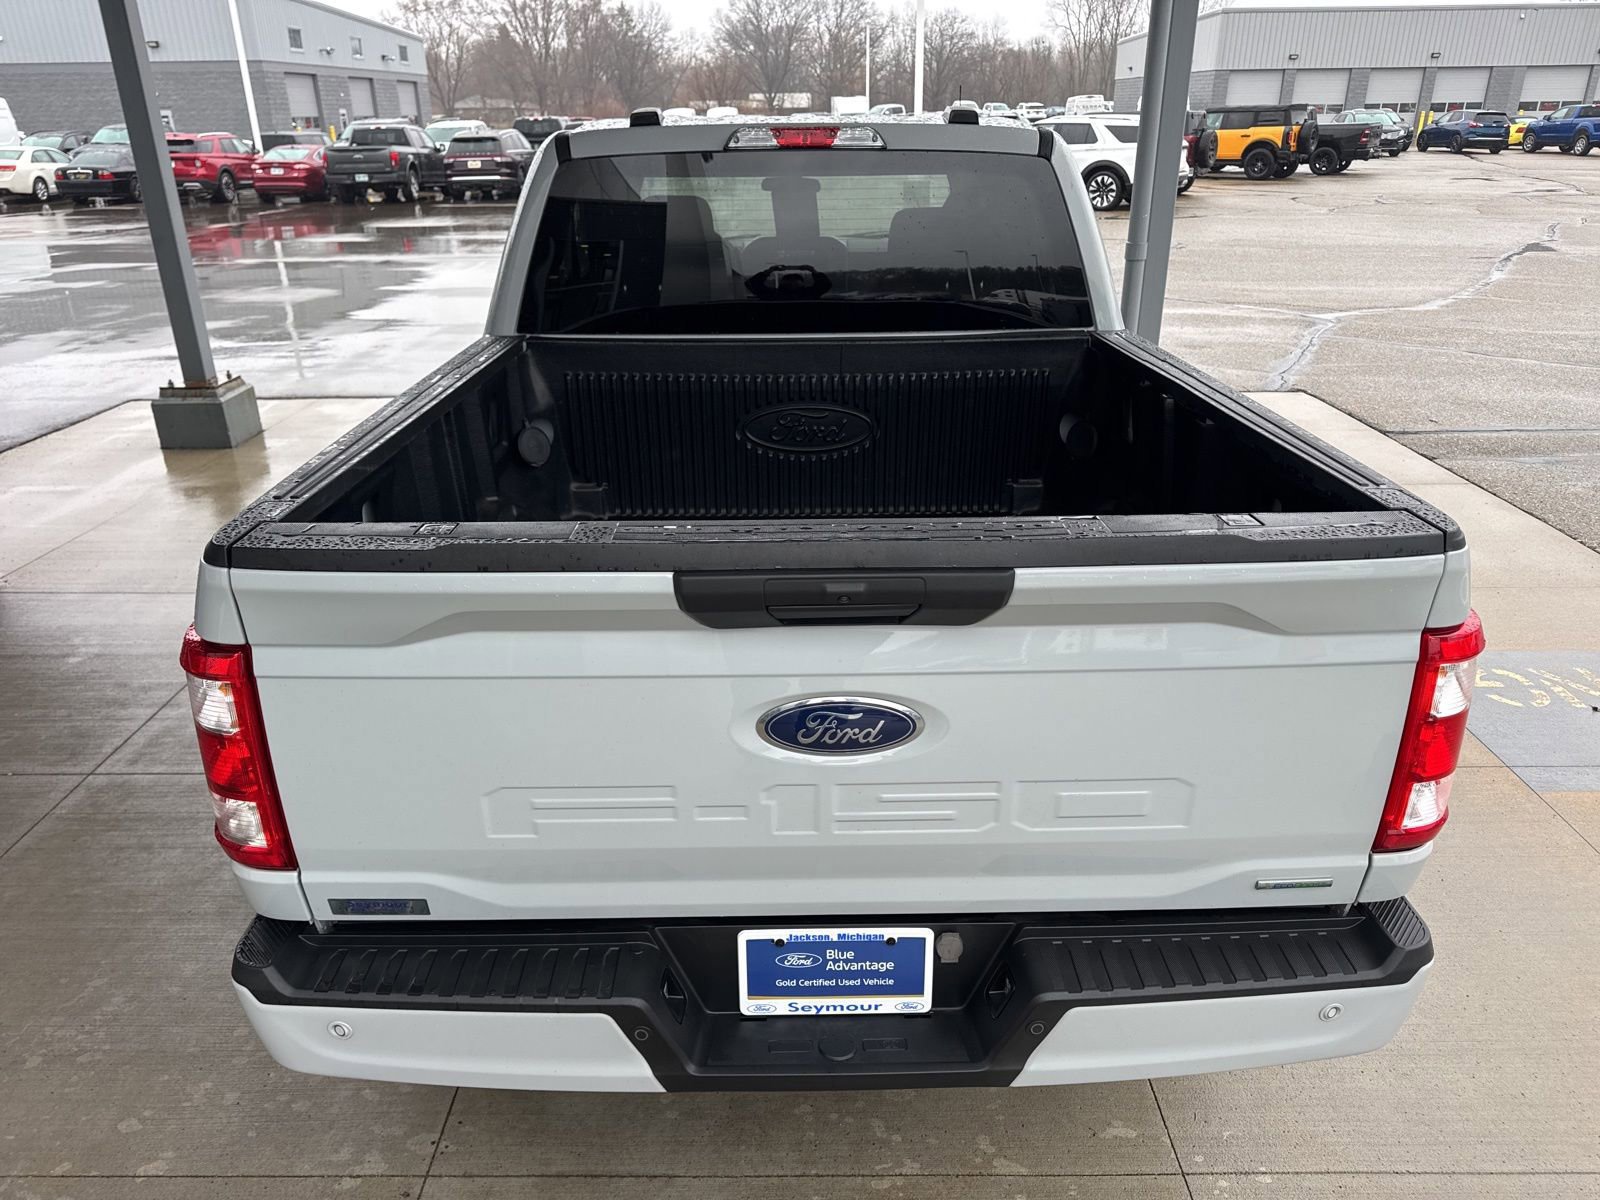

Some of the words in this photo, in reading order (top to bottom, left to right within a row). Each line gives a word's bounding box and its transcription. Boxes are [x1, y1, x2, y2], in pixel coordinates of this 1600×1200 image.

[768, 411, 847, 442] Ford
[797, 711, 884, 744] Ford
[481, 778, 1194, 838] F-150
[837, 933, 885, 941] Michigan
[784, 955, 813, 966] Ford
[826, 950, 855, 960] Blue
[826, 960, 895, 972] Advantage
[775, 979, 797, 987] Gold
[799, 978, 836, 987] Certified
[838, 978, 861, 986] Used
[863, 978, 895, 986] Vehicle
[753, 1004, 771, 1013] Ford
[788, 1001, 883, 1014] Seymour
[900, 1002, 918, 1011] Ford
